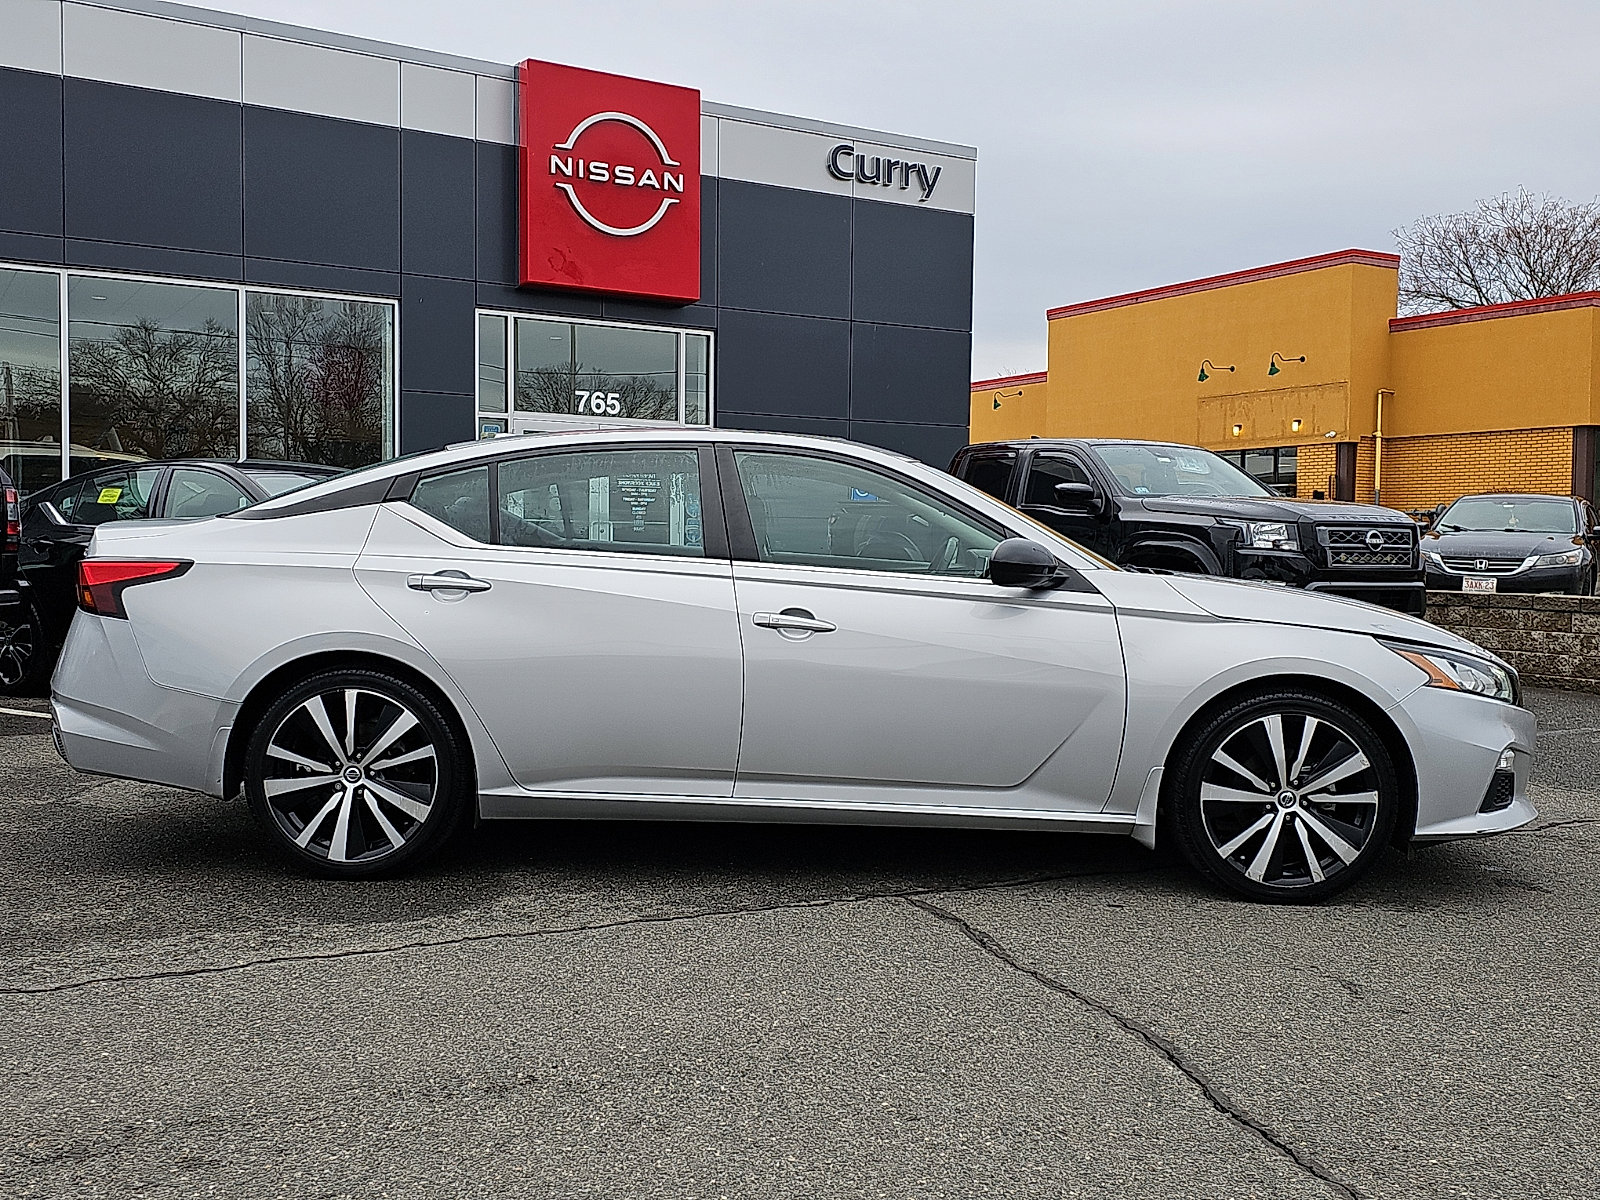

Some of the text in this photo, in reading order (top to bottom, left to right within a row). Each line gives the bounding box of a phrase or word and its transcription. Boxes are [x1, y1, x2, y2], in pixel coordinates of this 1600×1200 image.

[549, 153, 685, 193] NISSAN
[826, 144, 943, 202] Curry
[574, 390, 621, 415] 765
